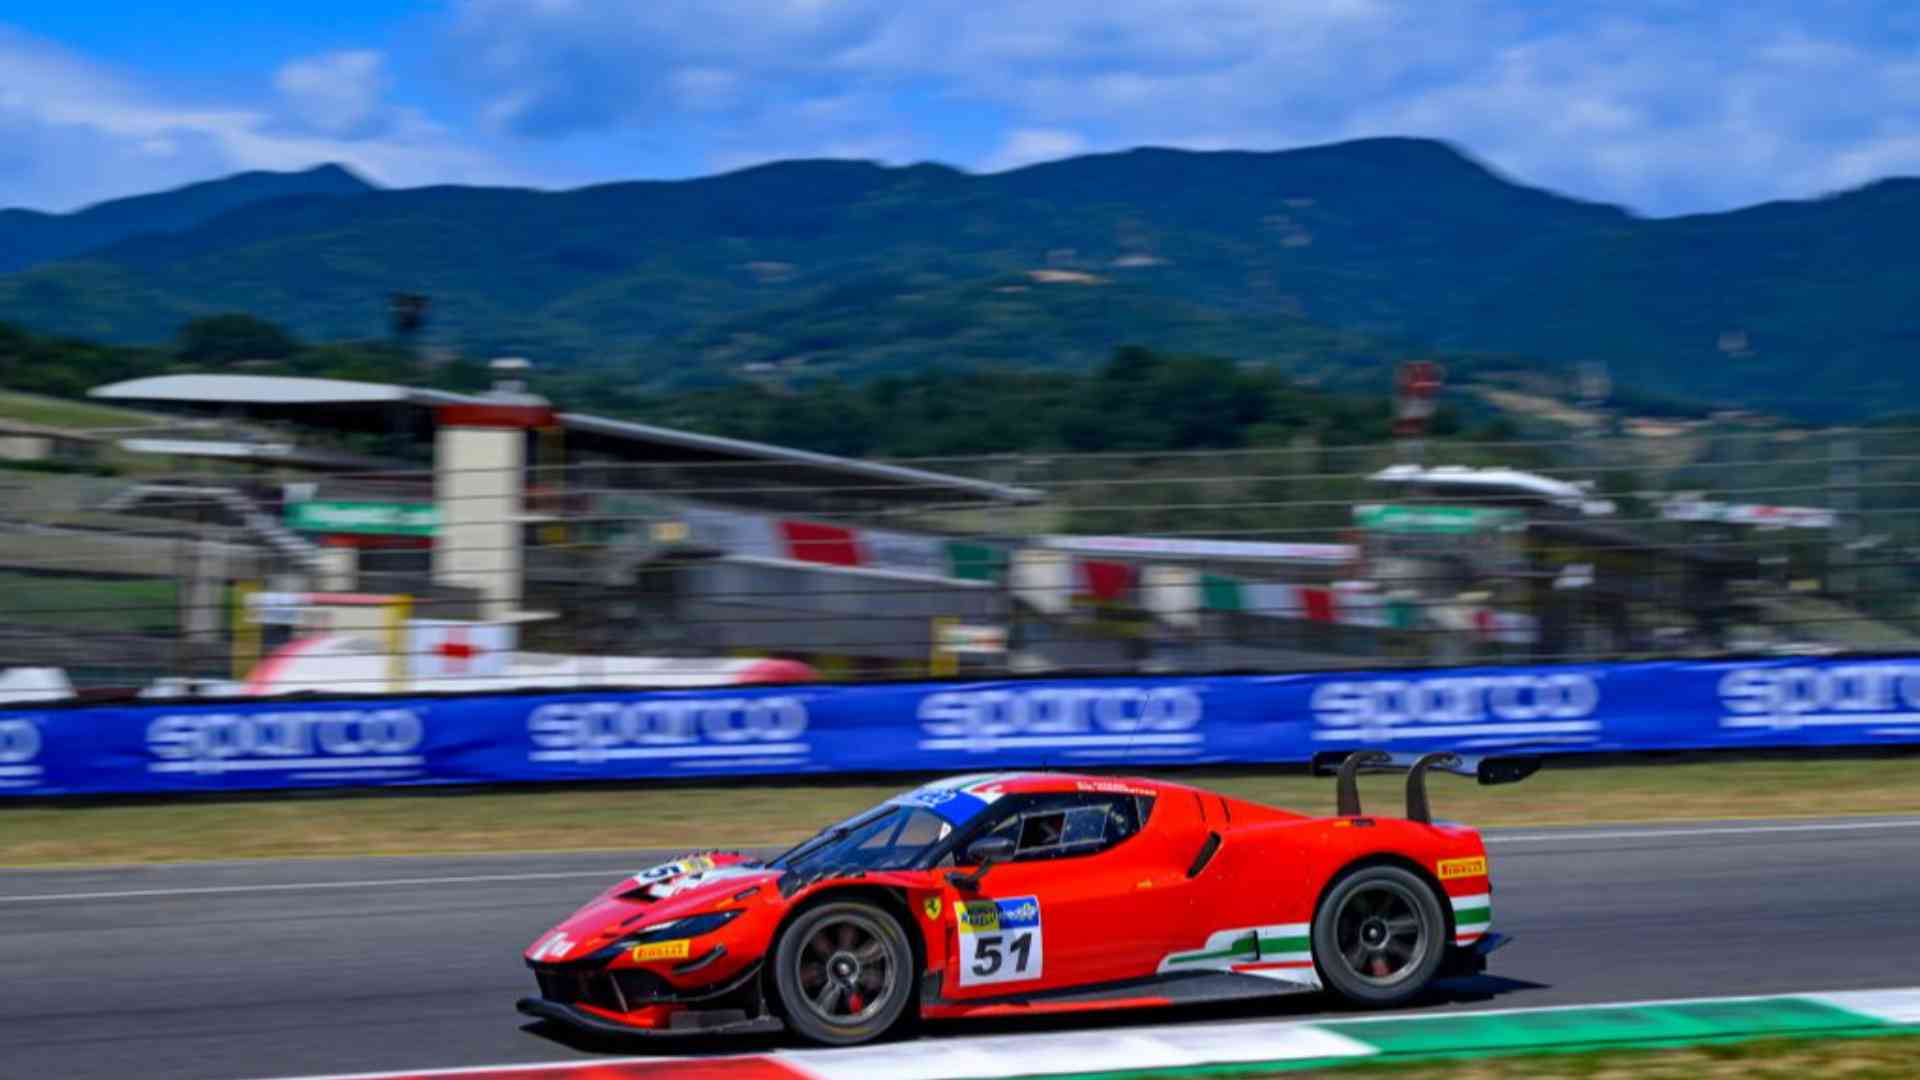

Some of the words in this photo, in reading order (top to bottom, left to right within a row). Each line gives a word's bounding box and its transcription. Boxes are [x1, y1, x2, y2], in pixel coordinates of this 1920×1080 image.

[145, 708, 425, 774] sparco
[527, 697, 809, 763] sparco
[916, 686, 1203, 752] sparco
[1311, 674, 1599, 742] sparco
[972, 932, 1032, 977] 51
